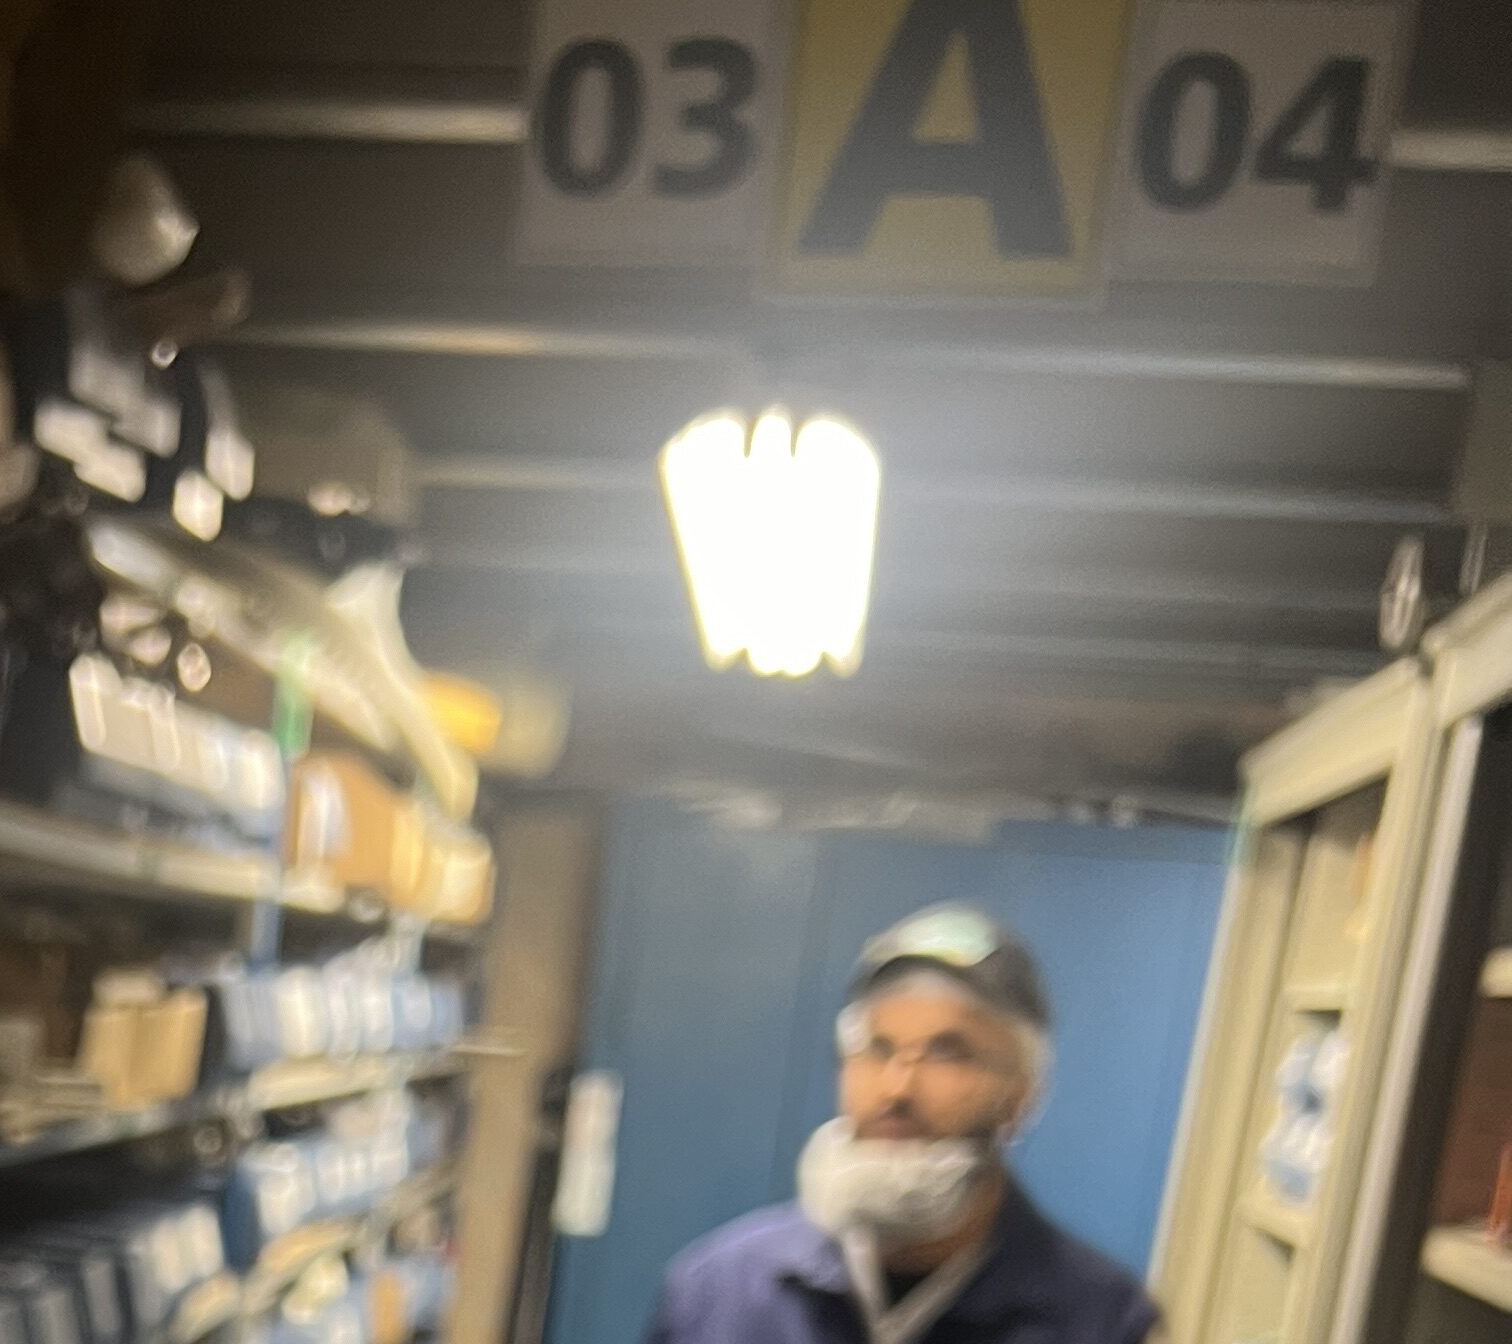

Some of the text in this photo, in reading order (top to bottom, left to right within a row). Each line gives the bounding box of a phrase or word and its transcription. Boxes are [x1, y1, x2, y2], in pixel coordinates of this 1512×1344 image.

[535, 35, 761, 198] 03
[797, 0, 1074, 260] A
[1136, 51, 1379, 212] 04
